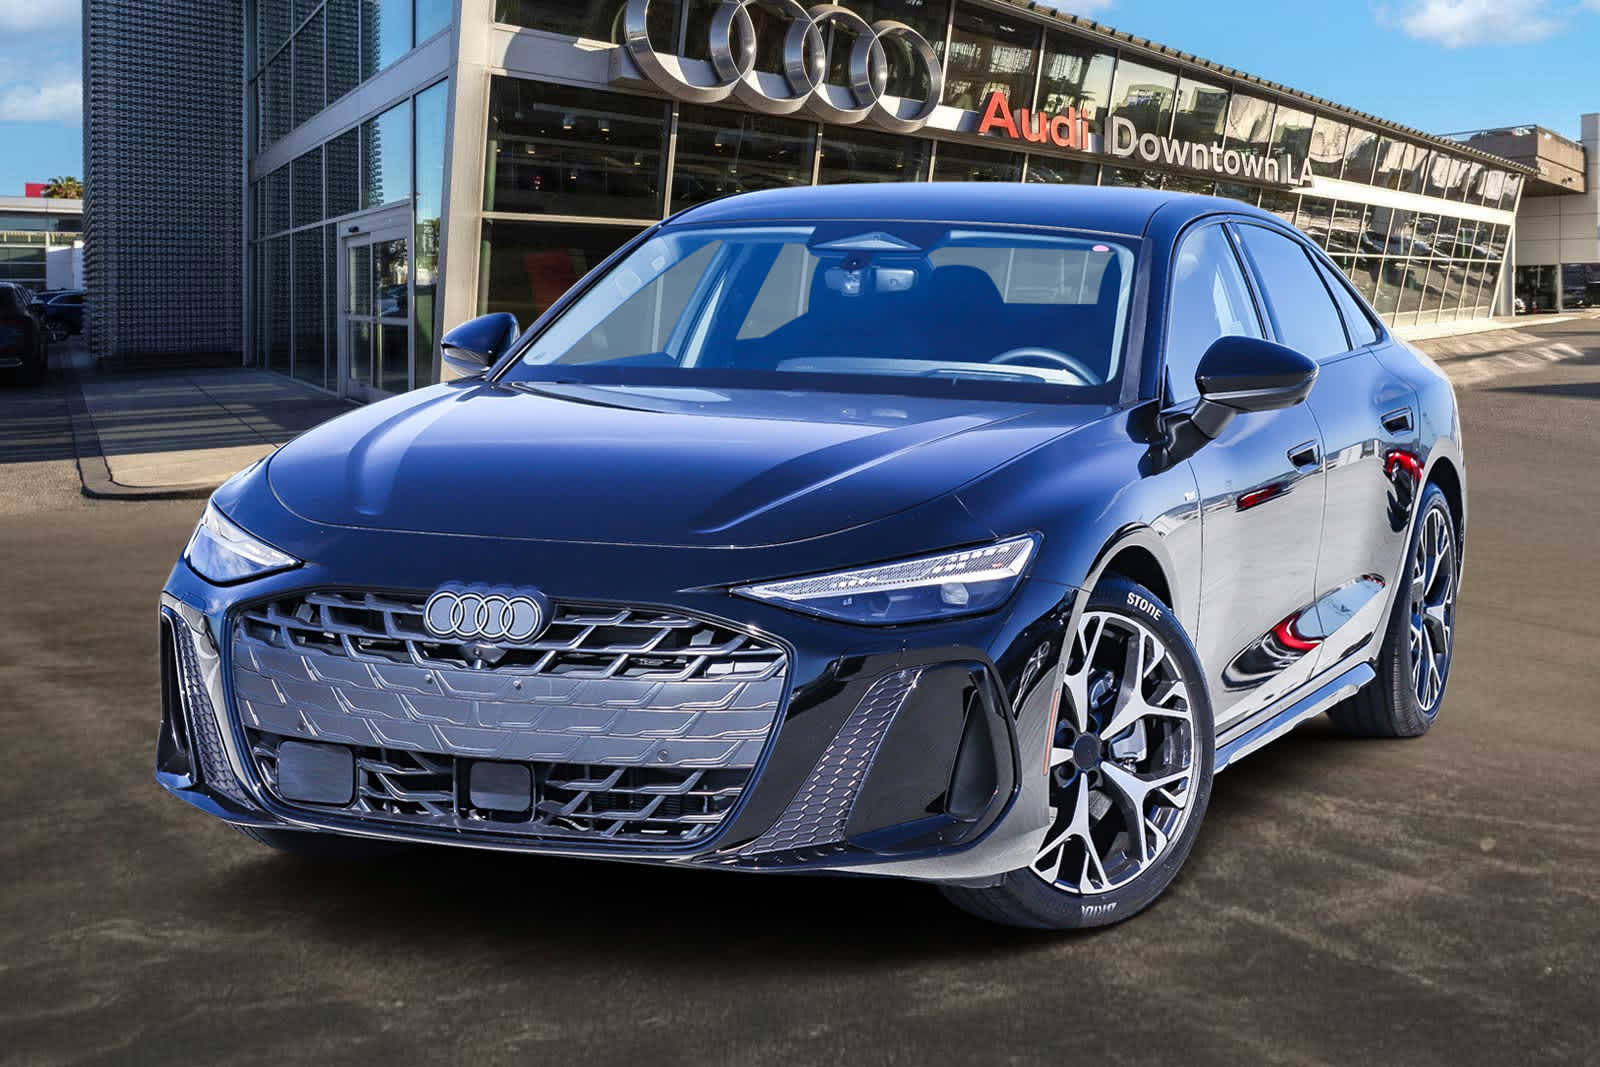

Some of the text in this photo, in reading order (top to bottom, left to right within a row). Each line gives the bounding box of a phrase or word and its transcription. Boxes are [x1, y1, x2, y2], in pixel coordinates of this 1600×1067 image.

[978, 91, 1315, 187] Audi Downtown LA
